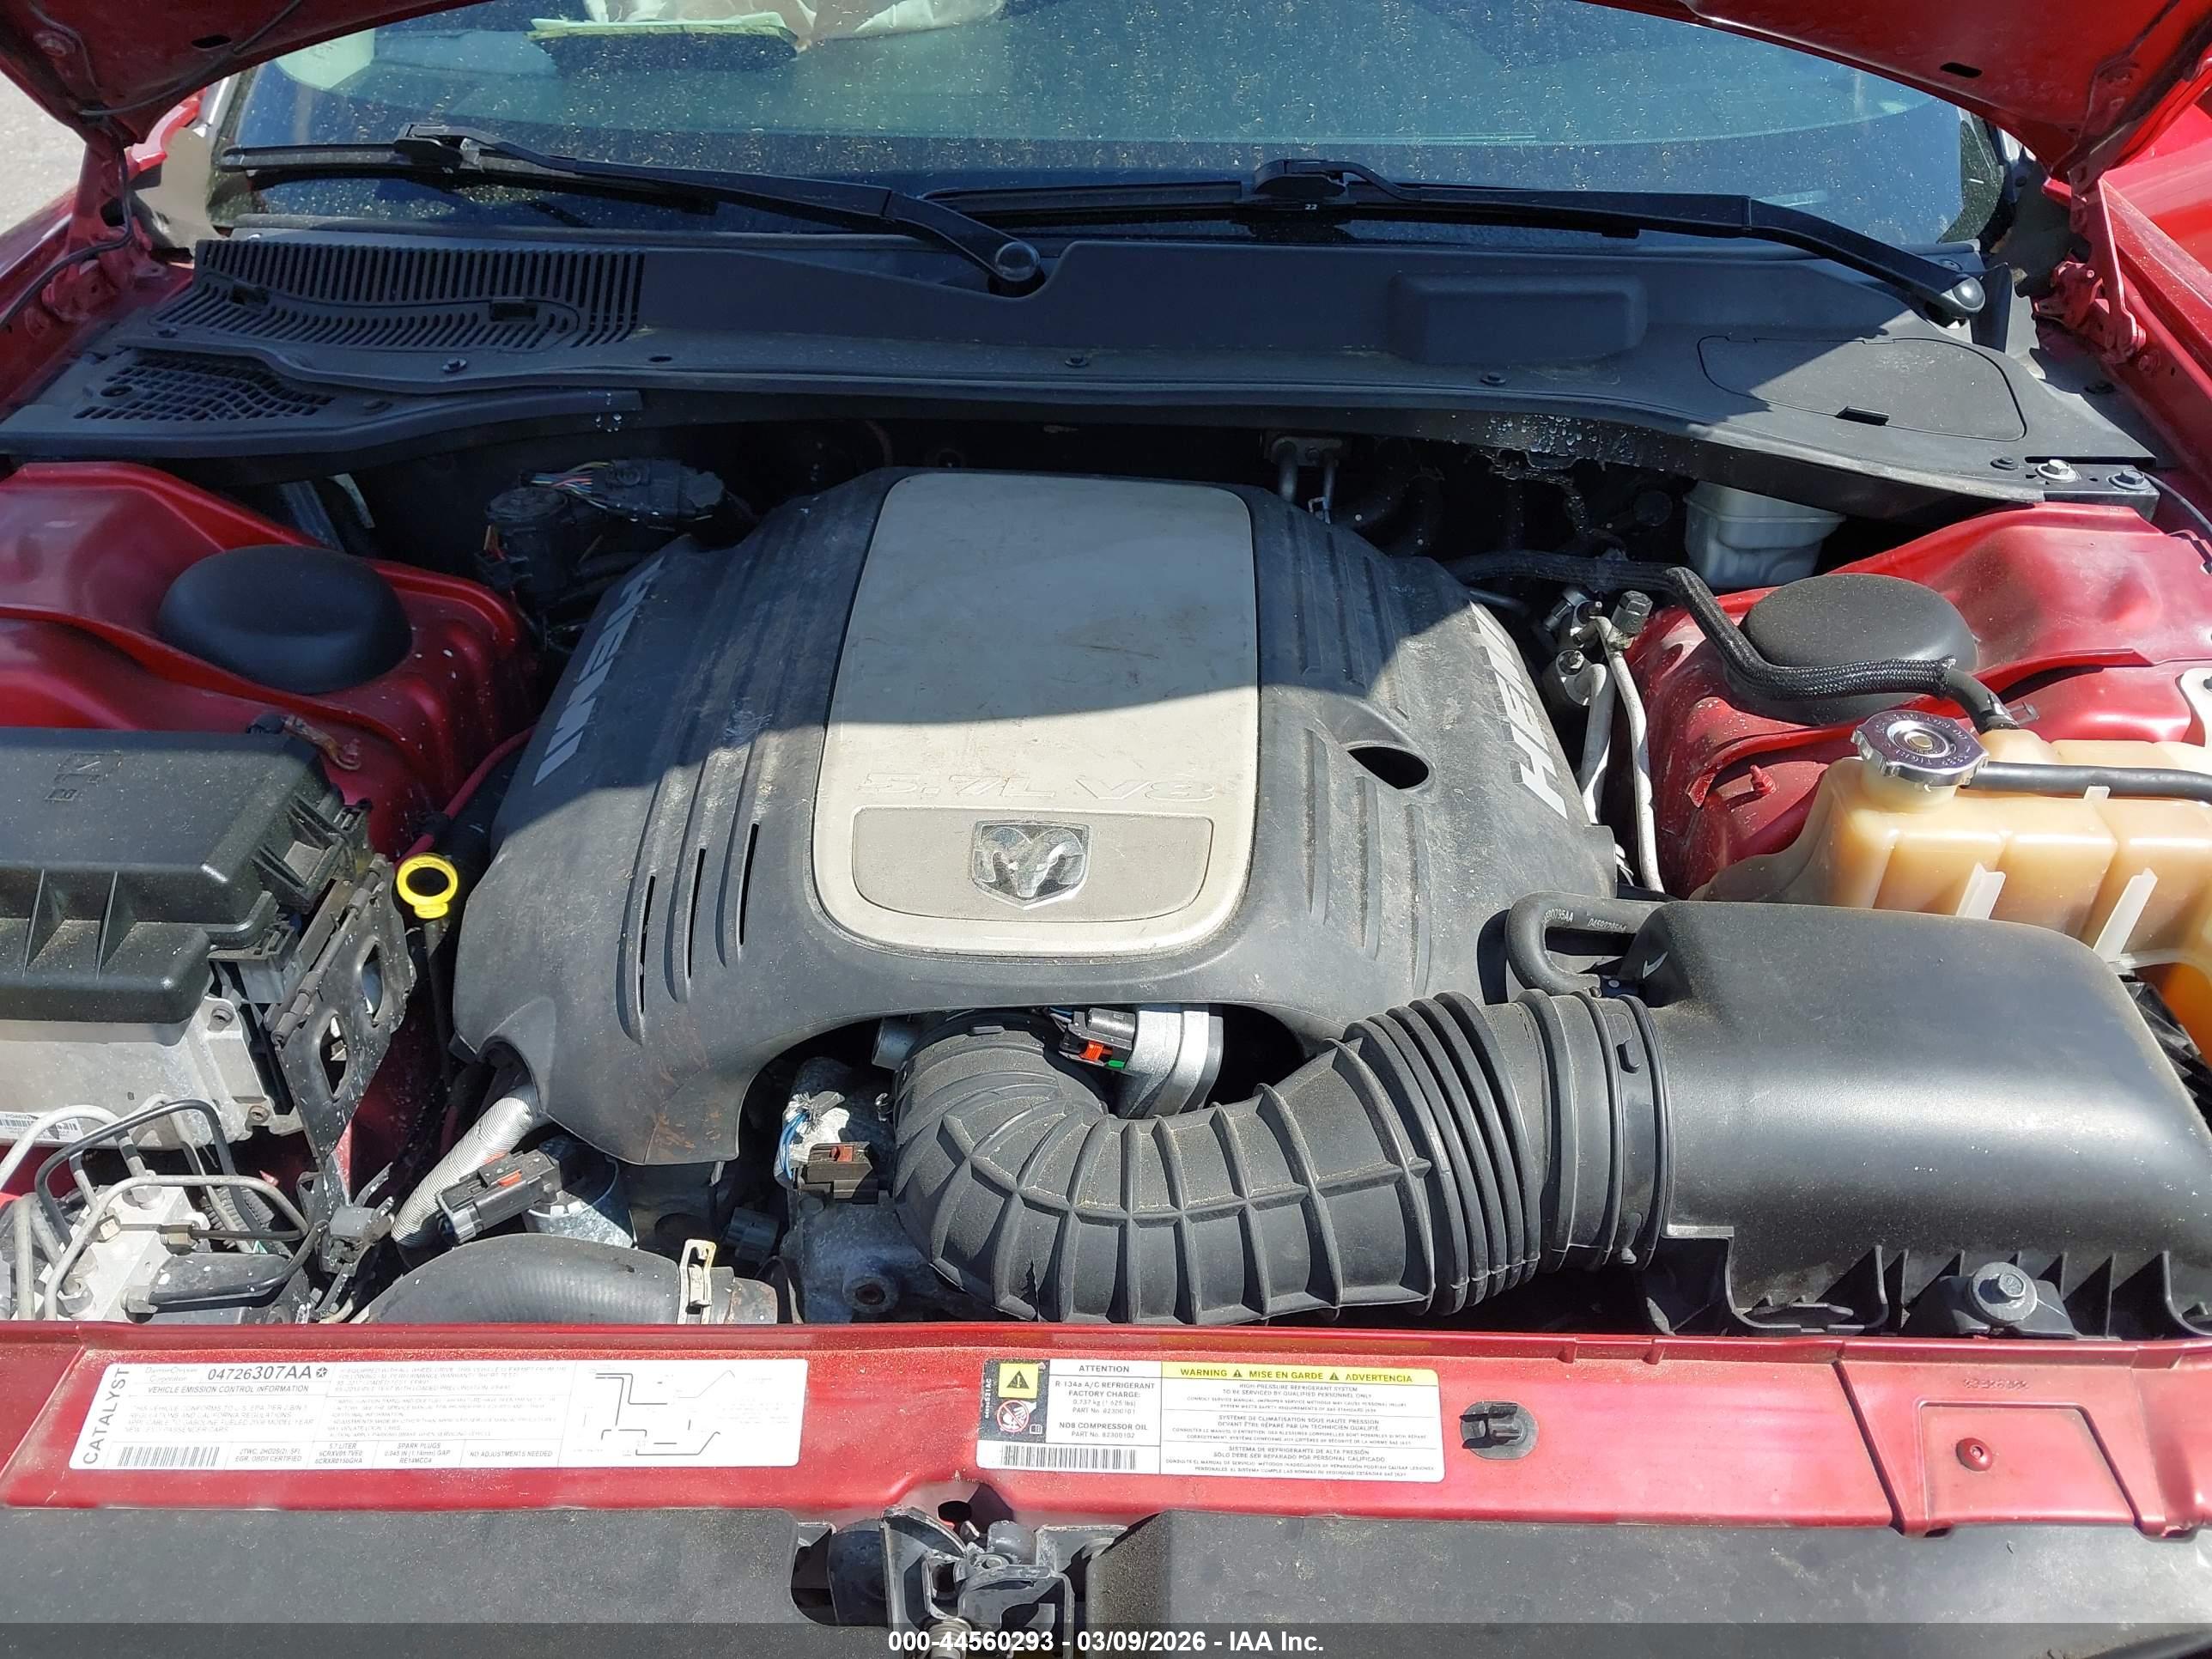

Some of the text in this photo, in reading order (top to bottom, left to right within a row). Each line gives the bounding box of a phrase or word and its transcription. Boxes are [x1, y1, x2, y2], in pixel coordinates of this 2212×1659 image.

[533, 556, 665, 787] HEMI
[1469, 599, 1568, 819] HEMI
[857, 773, 1215, 802] 5.7L V8
[207, 1365, 311, 1380] 04726307AA
[1079, 1365, 1130, 1373] ATTENTION
[1180, 1368, 1413, 1383] WARNING MISE EN GARDE ADVERTENCIA
[83, 1367, 129, 1465] CATALYST
